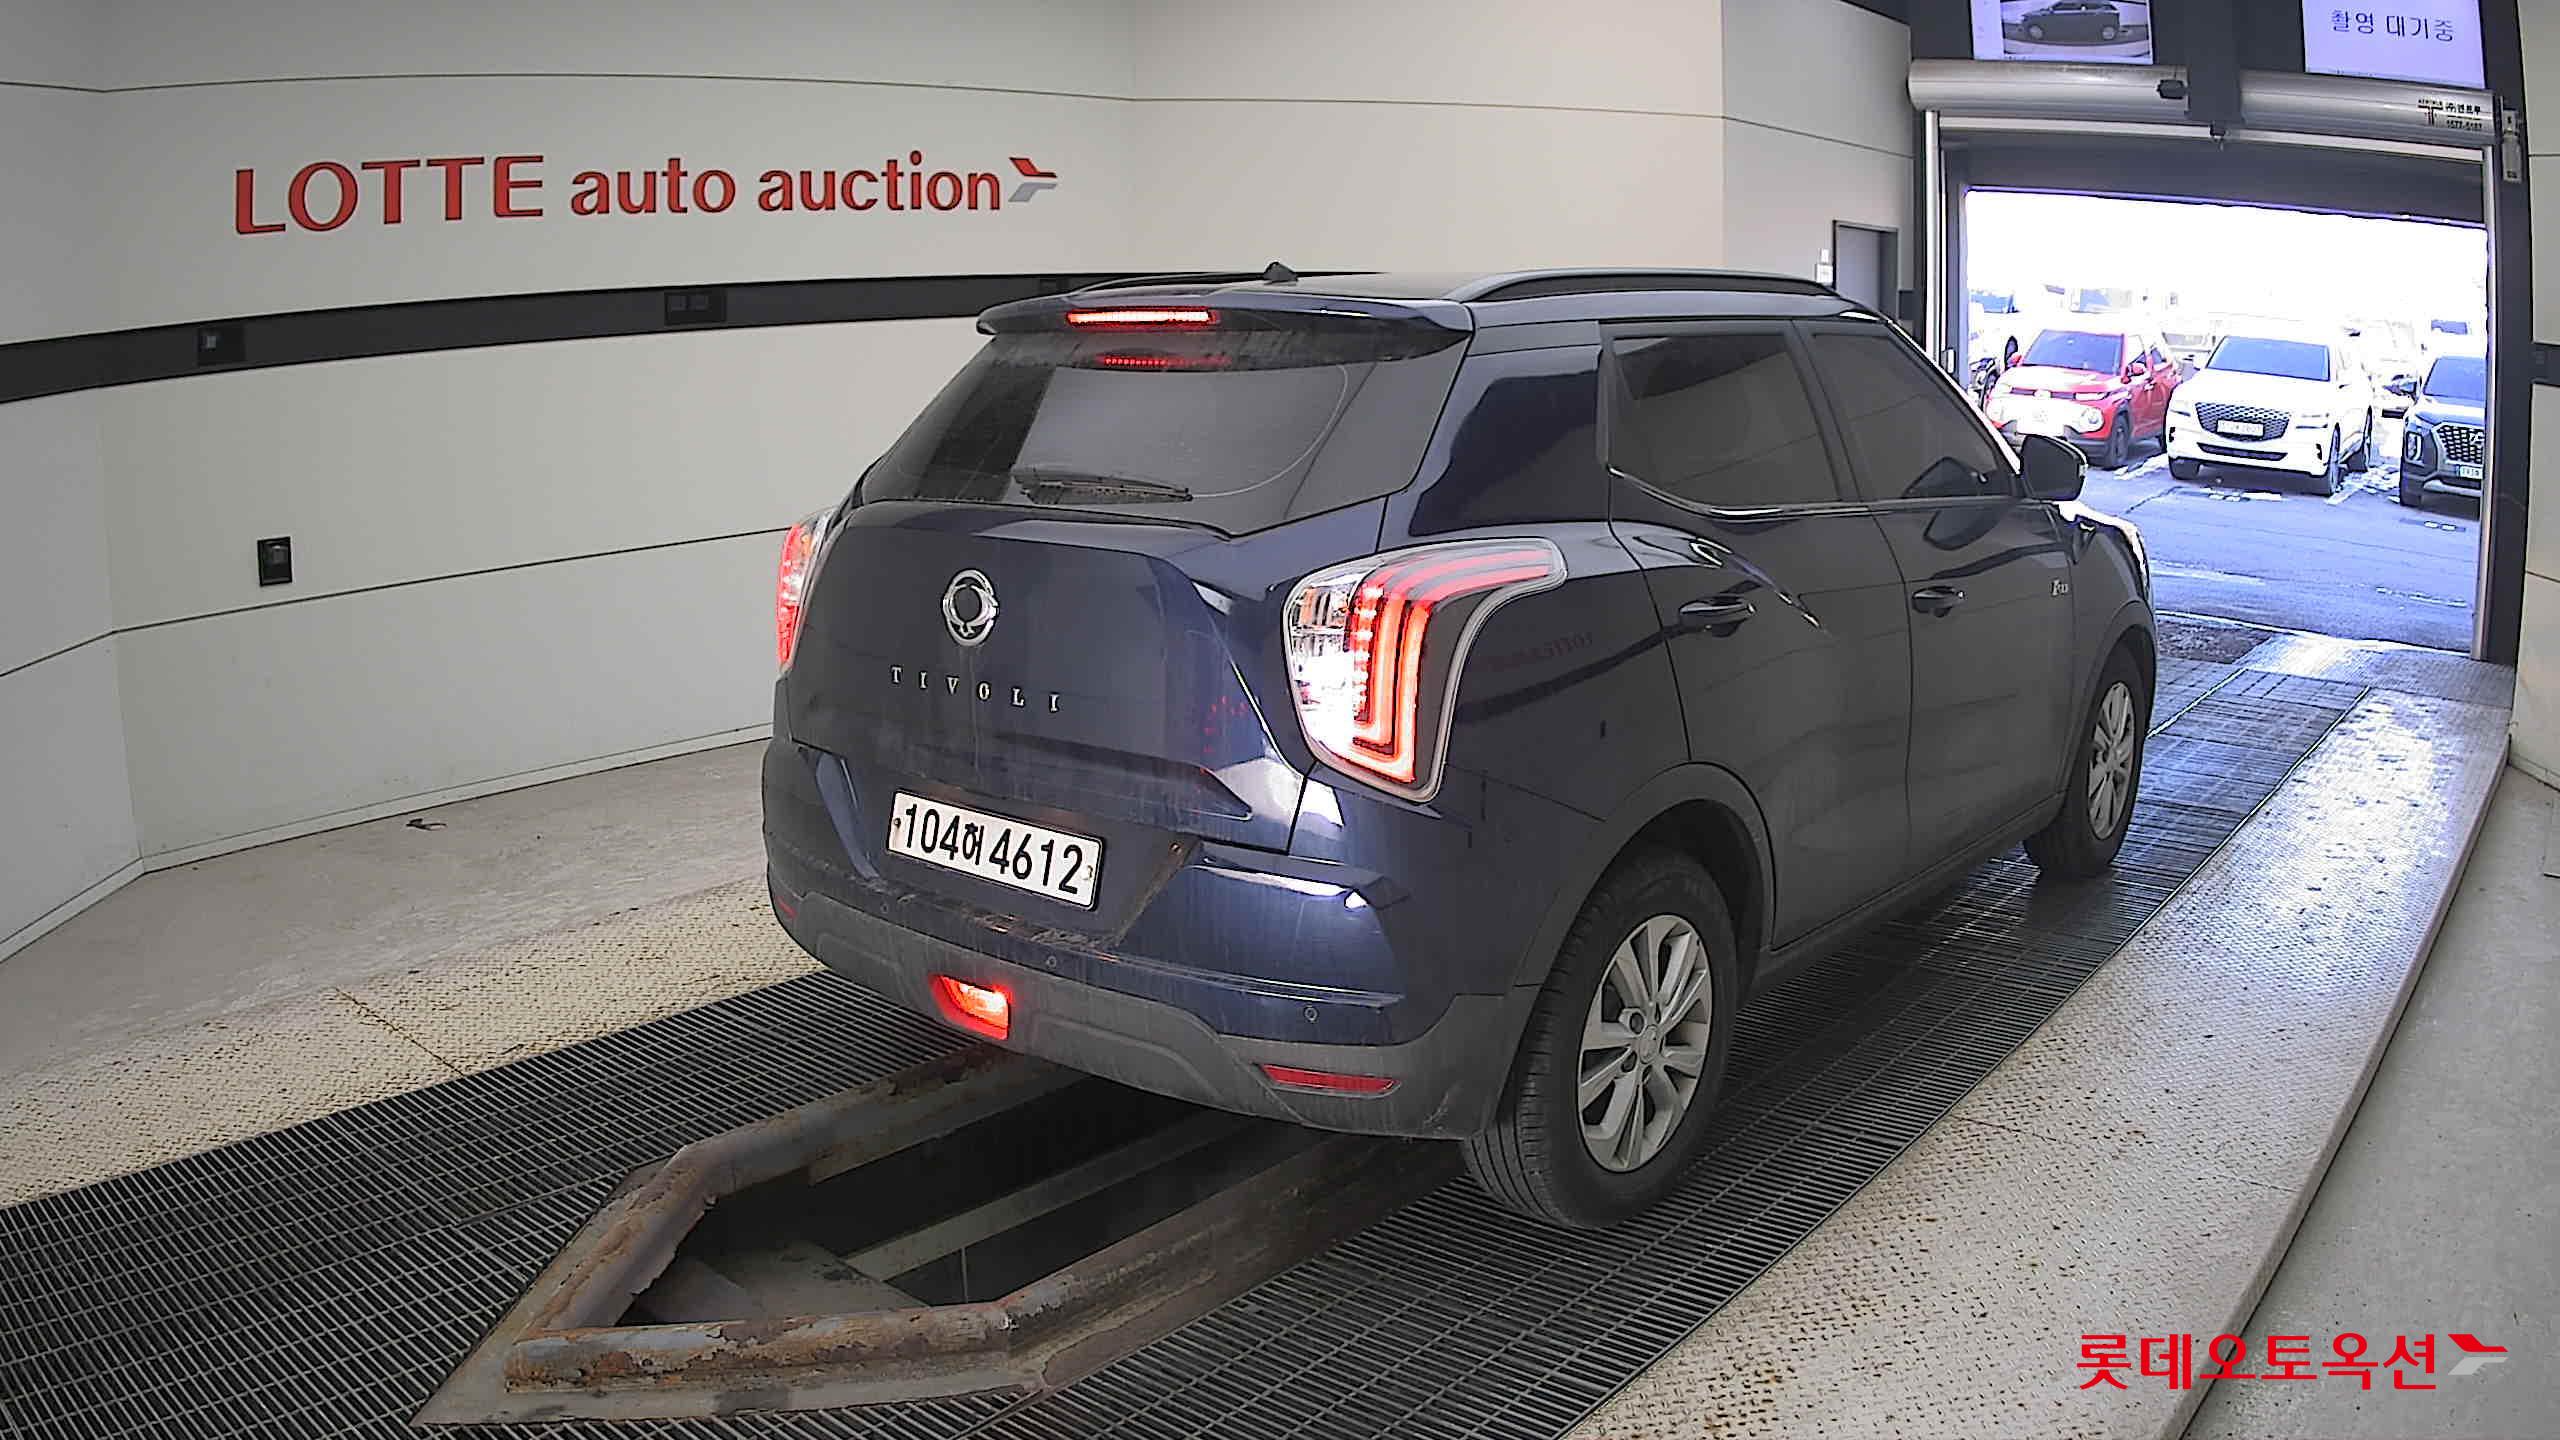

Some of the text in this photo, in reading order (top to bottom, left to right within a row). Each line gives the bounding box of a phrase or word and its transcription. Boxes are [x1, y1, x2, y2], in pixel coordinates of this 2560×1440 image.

[2332, 10, 2375, 34] 촬영
[235, 150, 1002, 235] LOTTE auto auction
[891, 666, 1061, 713] TIVOLI
